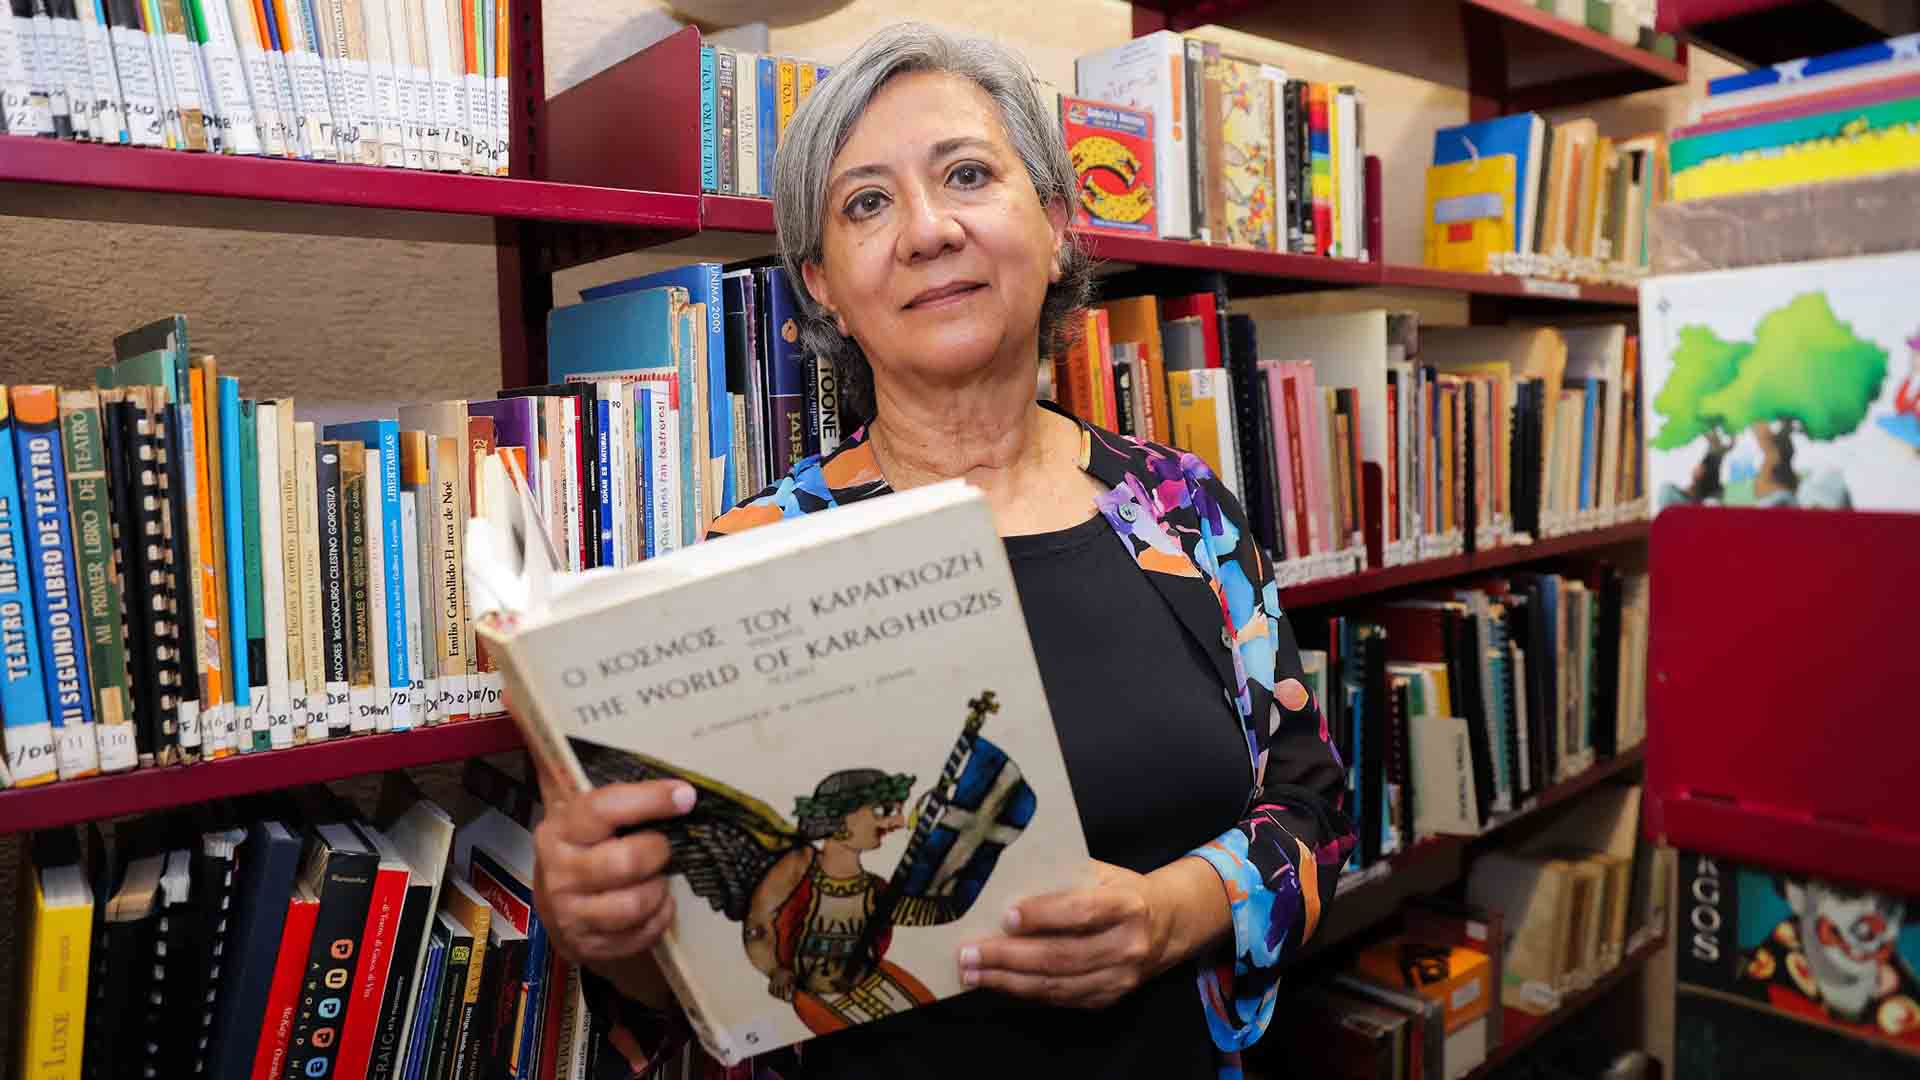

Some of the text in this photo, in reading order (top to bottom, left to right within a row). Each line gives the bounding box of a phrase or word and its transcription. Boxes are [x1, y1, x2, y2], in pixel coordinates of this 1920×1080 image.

[702, 102, 713, 149] TEATRO
[710, 265, 721, 334] UNIMA 2000
[819, 366, 837, 439] TOONE
[385, 433, 397, 503] LIBERTABLAS
[600, 431, 608, 463] NATURAL
[28, 437, 57, 516] TEATRO
[442, 480, 454, 505] Noé
[39, 520, 61, 546] DE
[69, 409, 114, 645] MI PRIMER LIBRO DE TEATRO
[326, 485, 339, 535] GOROSTIZA
[444, 507, 454, 521] de
[328, 536, 340, 578] CELESTINO
[446, 523, 455, 547] arca
[446, 549, 456, 561] El
[42, 550, 70, 610] LIBRO
[330, 580, 342, 629] CONCURSO
[1, 602, 31, 681] TEATRO
[51, 612, 82, 705] SEGUNDO
[447, 621, 460, 657] Emilio
[574, 697, 629, 726] THE
[637, 664, 740, 708] WORLD
[753, 648, 792, 675] OF
[805, 586, 1003, 661] KARAGHIOZIS
